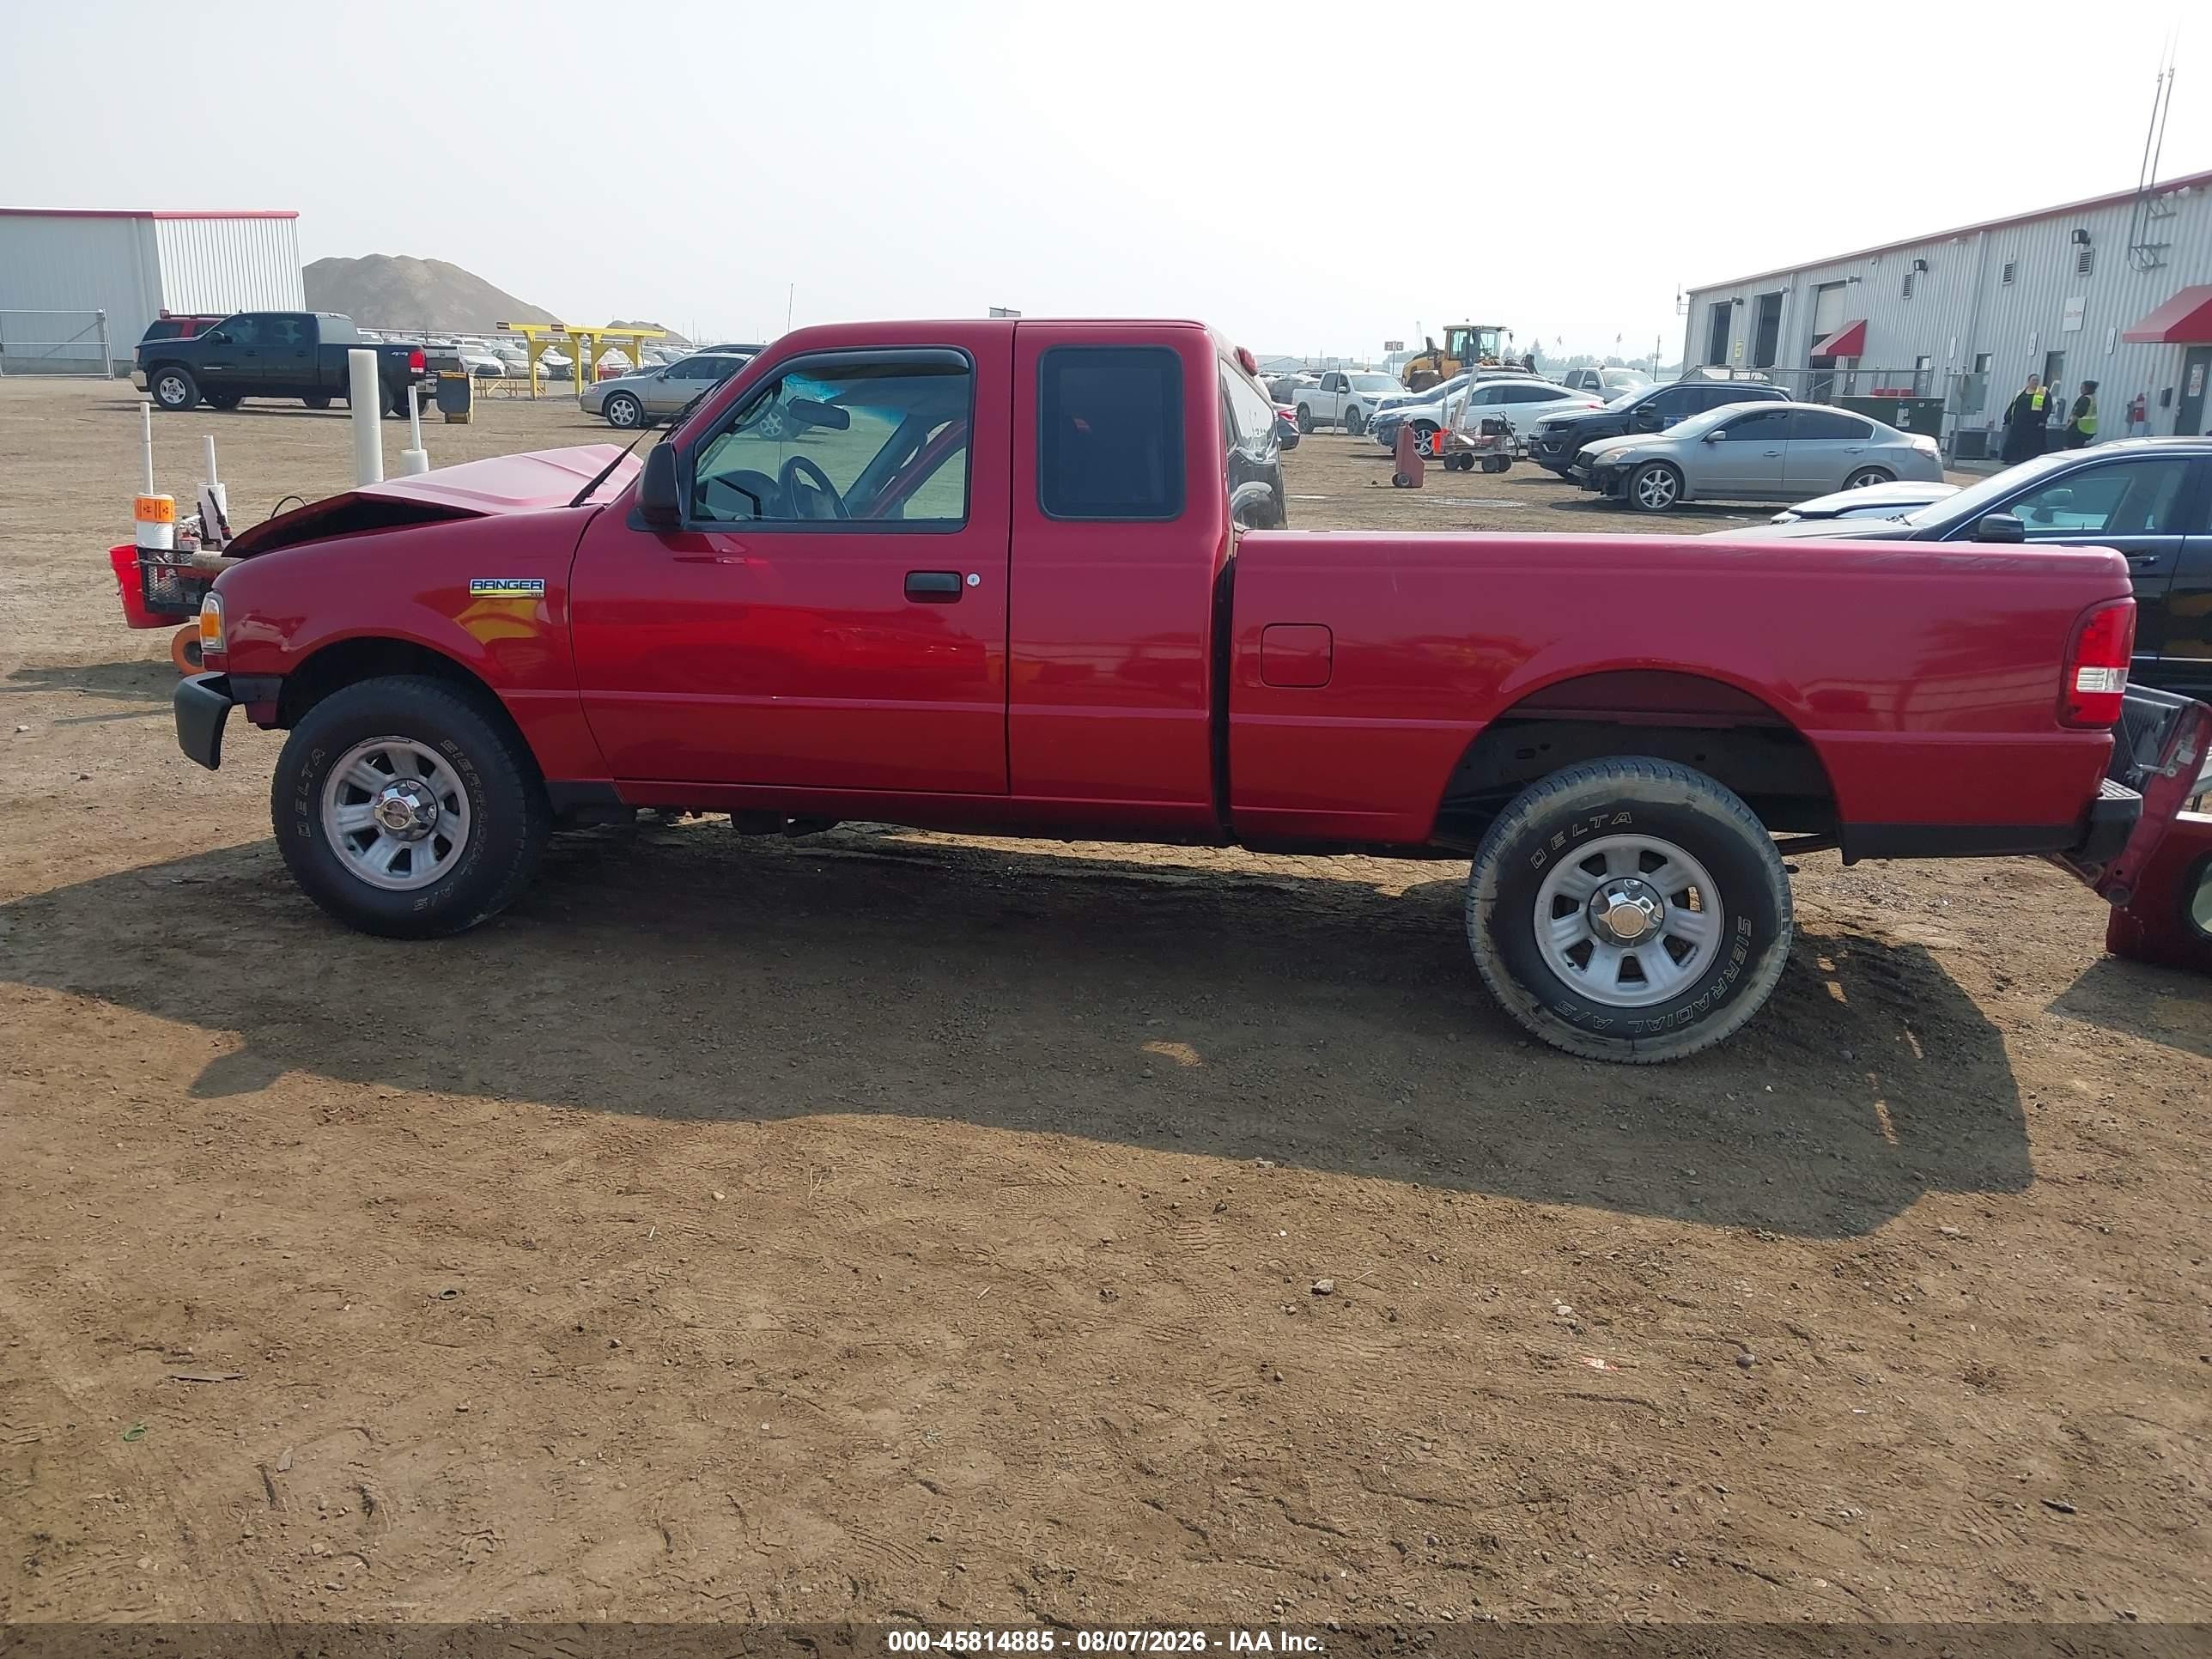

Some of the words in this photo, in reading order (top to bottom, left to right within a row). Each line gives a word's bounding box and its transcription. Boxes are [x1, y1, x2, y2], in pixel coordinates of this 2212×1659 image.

[471, 580, 544, 590] RANGER
[295, 748, 326, 838] DELTA
[1529, 811, 1633, 870] DELTA
[1626, 915, 1753, 1033] SIERRADIAL
[1553, 1000, 1614, 1030] A/S
